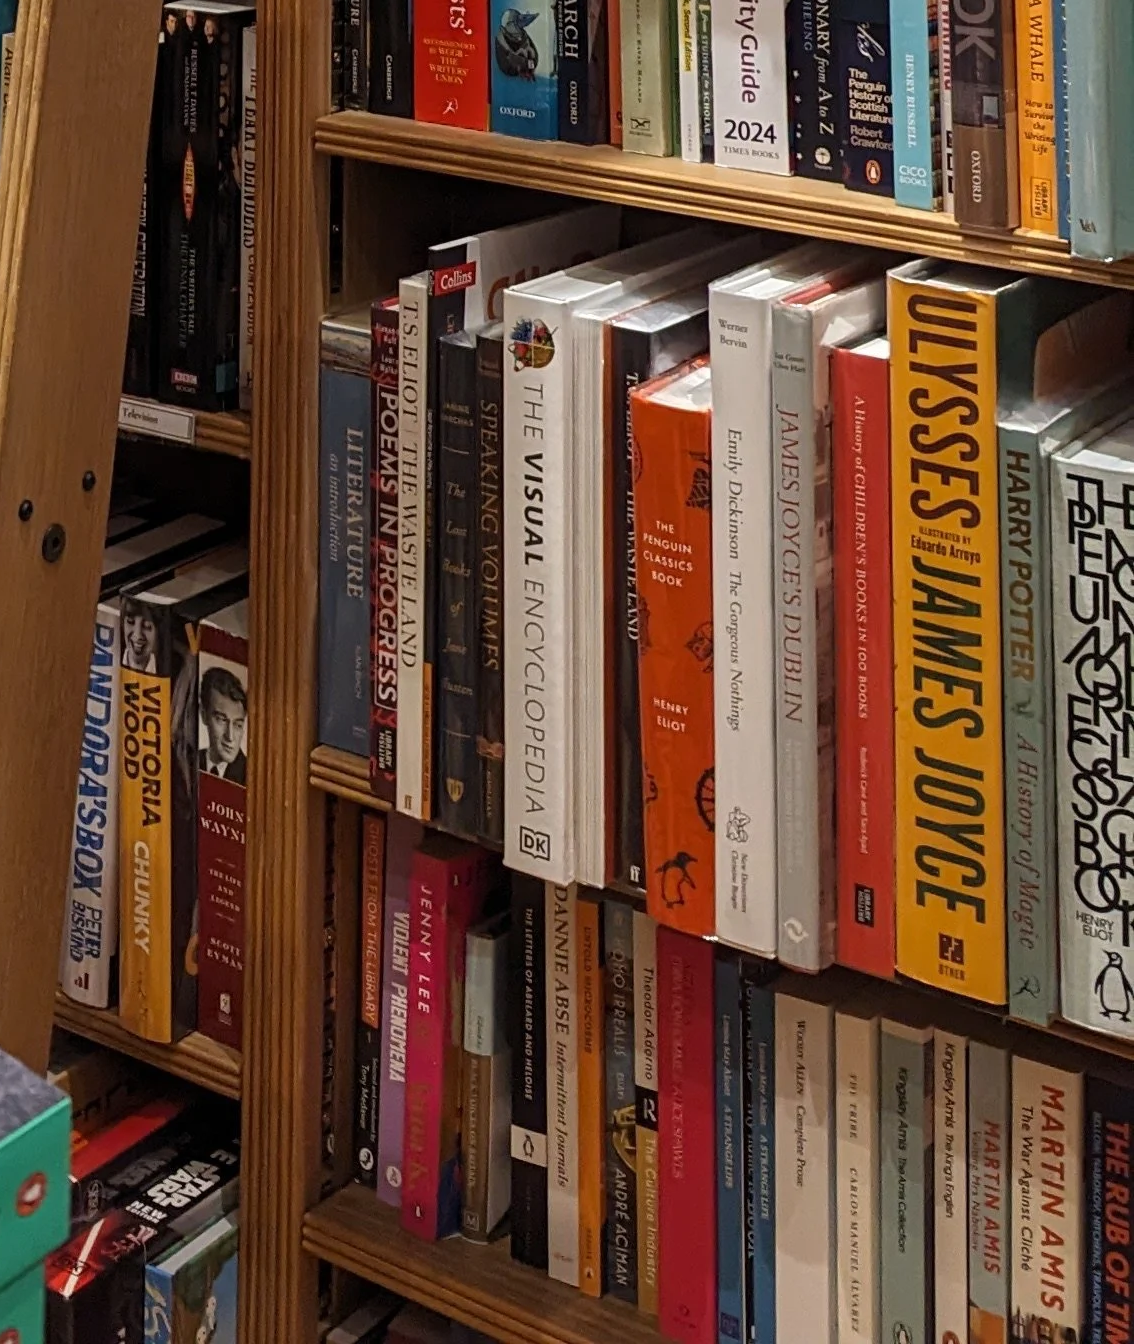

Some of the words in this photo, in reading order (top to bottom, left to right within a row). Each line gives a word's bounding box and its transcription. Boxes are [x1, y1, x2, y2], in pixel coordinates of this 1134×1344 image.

[738, 29, 760, 105] Guide
[724, 119, 777, 145] 2024
[439, 269, 473, 292] Collins
[908, 292, 982, 530] ULYSSES
[523, 453, 547, 566] VISUAL
[1005, 447, 1034, 560] HARRY
[912, 555, 986, 738] JAMES
[1007, 558, 1036, 683] POTTER
[124, 681, 140, 781] WOOD
[522, 573, 547, 813] ENCYCLOPEDIA
[142, 684, 162, 827] VICTORIA
[915, 744, 987, 926] JOYCE
[132, 840, 151, 956] CHUNKY
[1040, 1084, 1065, 1219] MARTIN
[1040, 1221, 1065, 1312] AMIS
